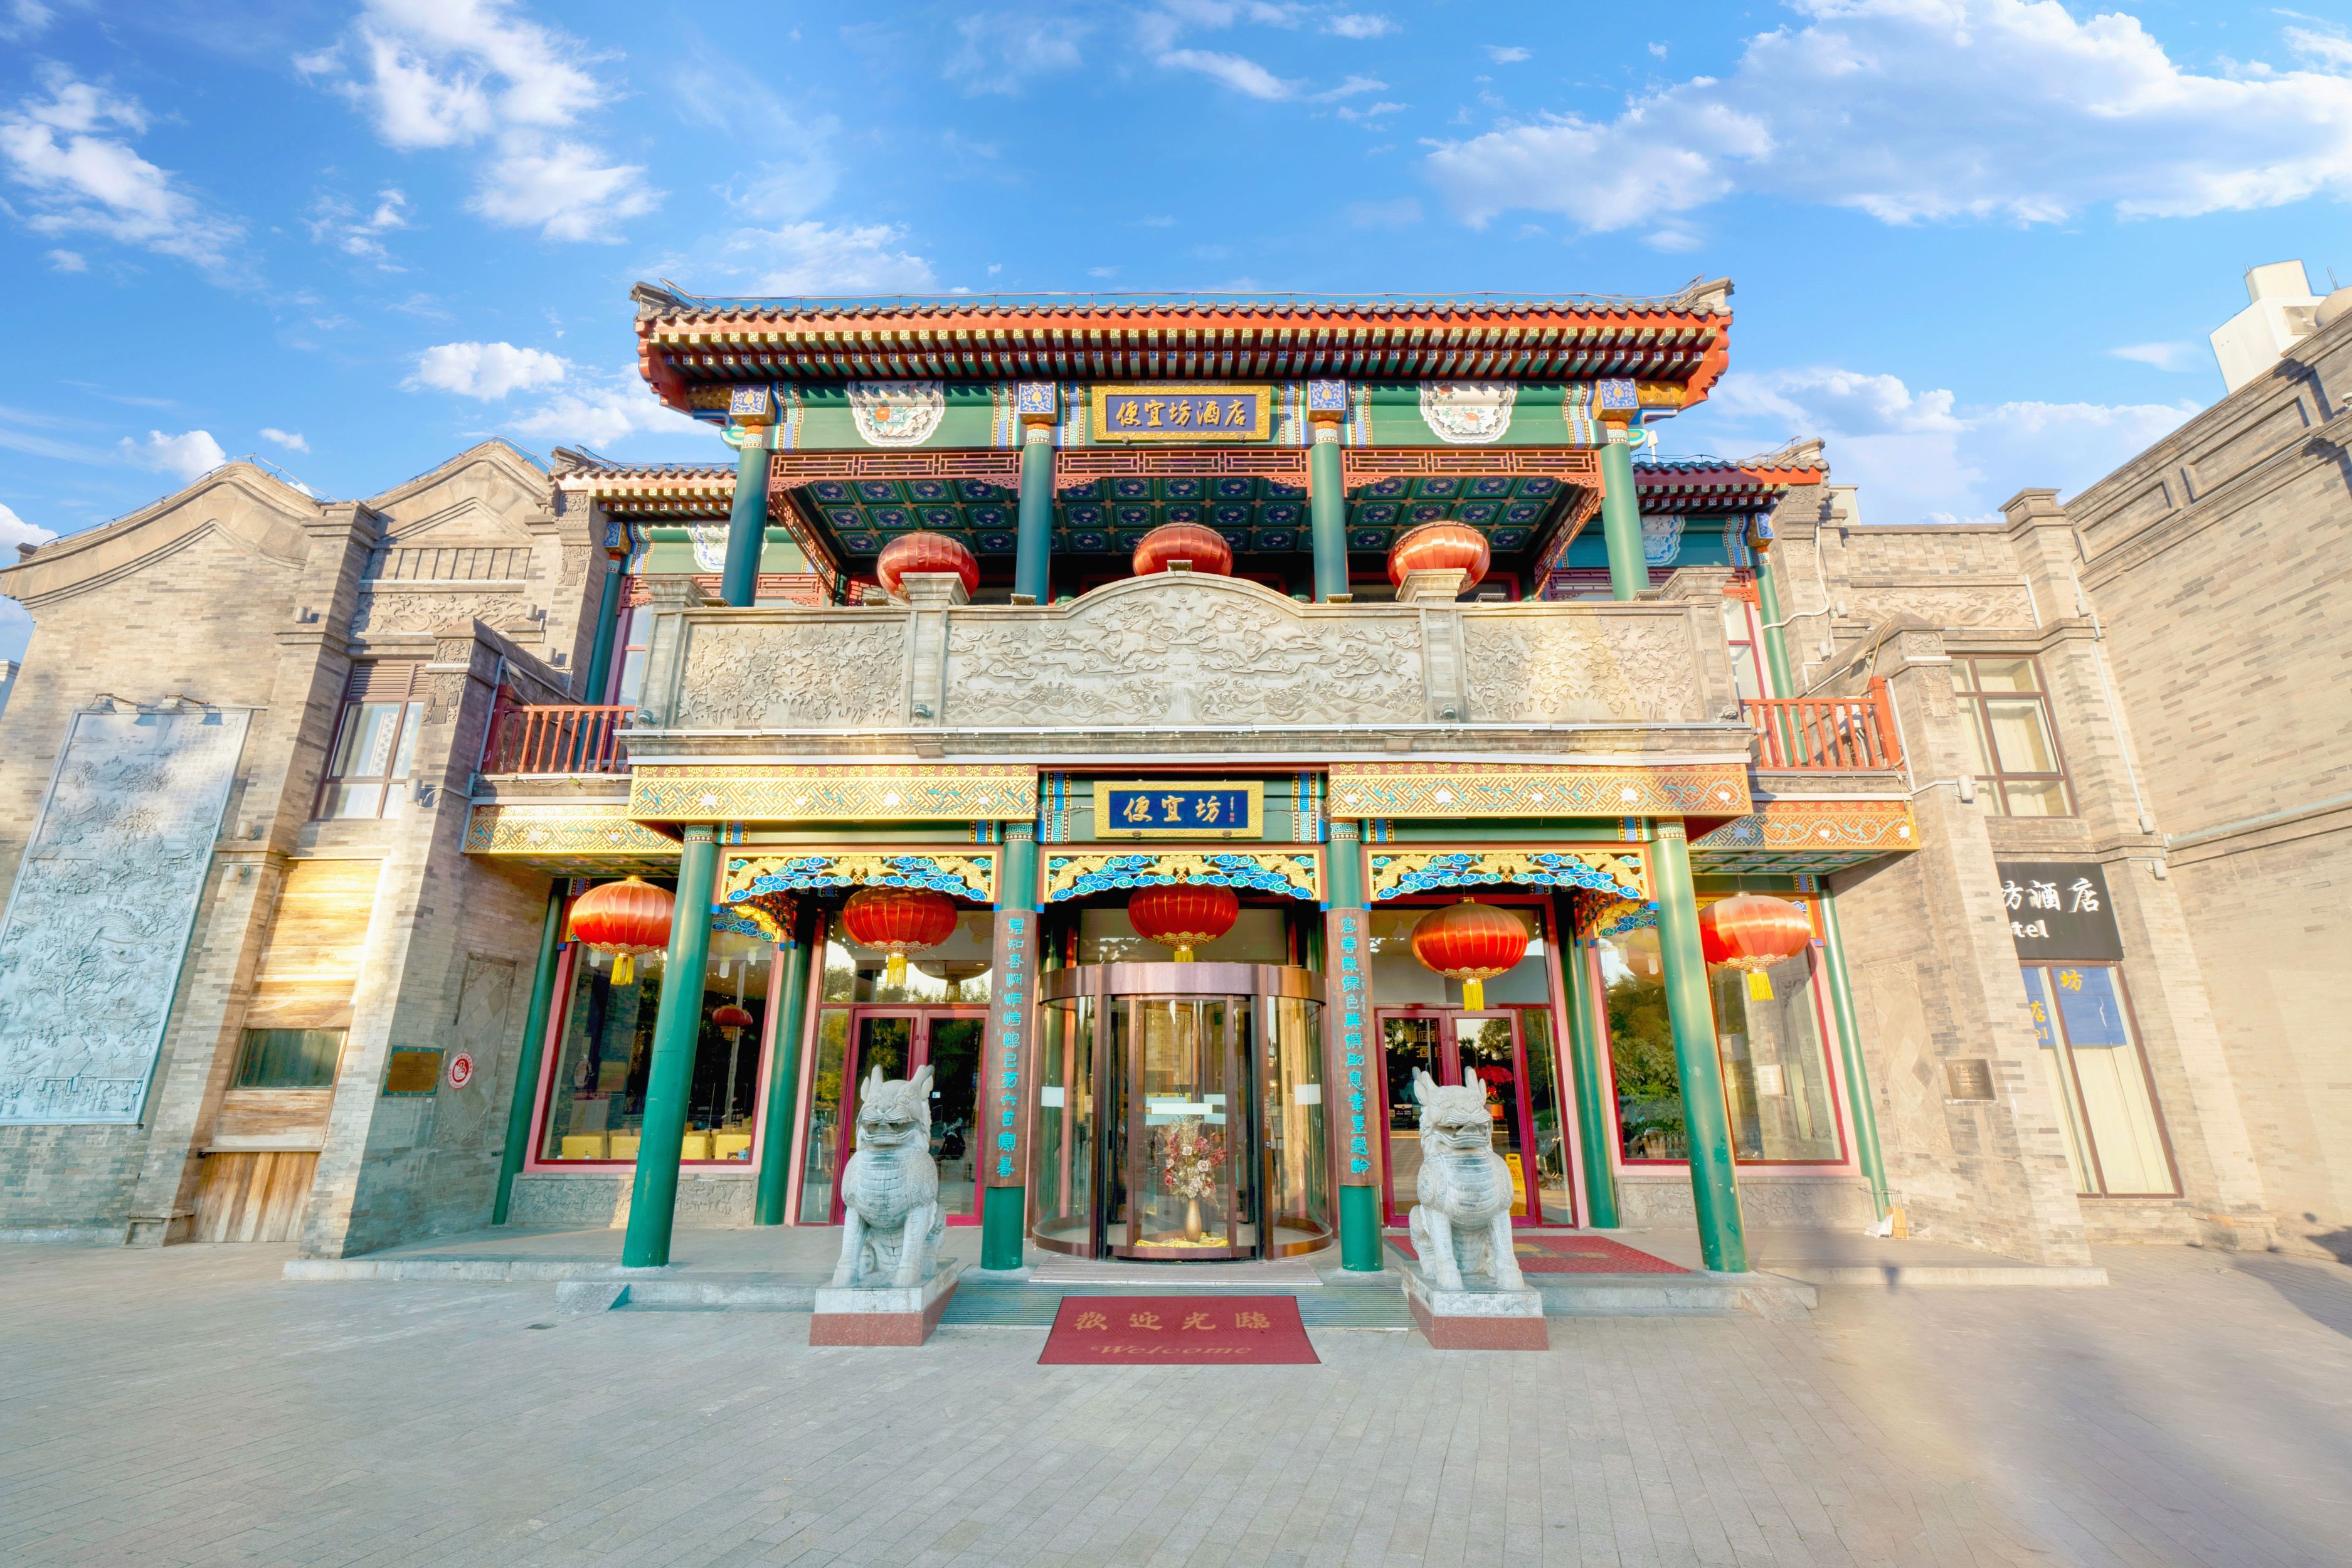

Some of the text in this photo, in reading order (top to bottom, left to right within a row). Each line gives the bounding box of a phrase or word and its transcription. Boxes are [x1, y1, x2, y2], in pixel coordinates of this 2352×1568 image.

[1116, 399, 1246, 428] 便宜坊酒店
[1123, 795, 1221, 823] 便宜坊
[2059, 969, 2083, 992] 坊
[1090, 1345, 1253, 1355] Welcome
